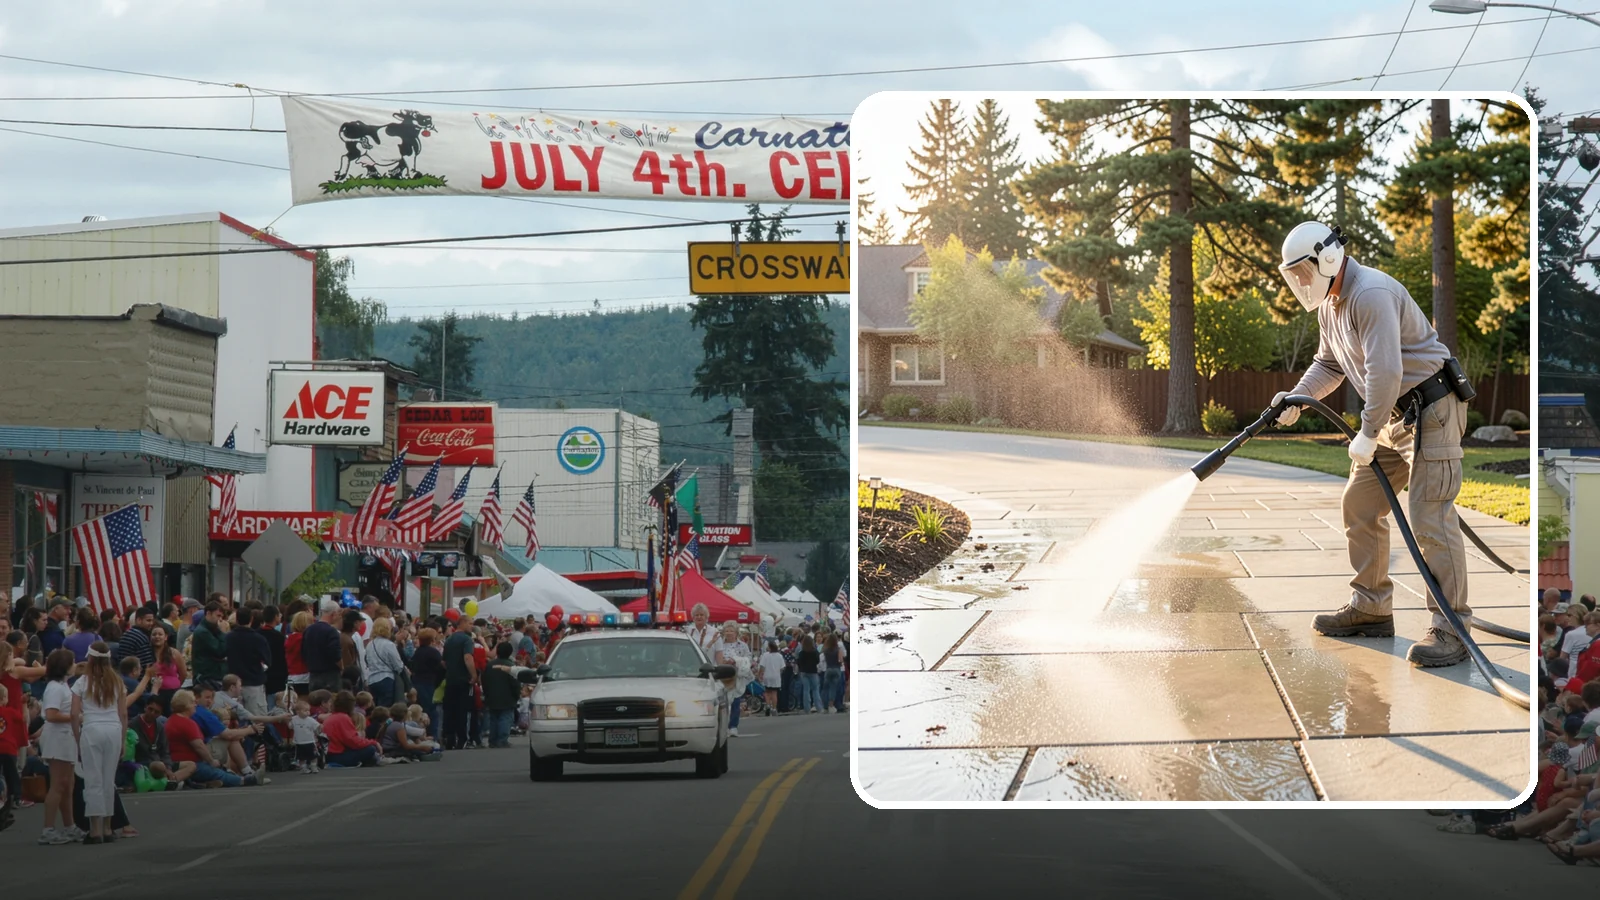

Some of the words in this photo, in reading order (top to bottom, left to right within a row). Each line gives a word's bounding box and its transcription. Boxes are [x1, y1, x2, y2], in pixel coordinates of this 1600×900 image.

[695, 121, 850, 149] Carnat
[481, 141, 605, 193] JULY
[632, 150, 746, 198] 4th.
[697, 254, 850, 279] CROSSWA
[283, 380, 373, 420] ACE
[405, 409, 452, 422] CEDAR
[461, 409, 485, 421] LOG
[283, 421, 370, 436] Hardware
[353, 467, 384, 482] Simpl
[95, 485, 124, 495] Vincent
[126, 485, 136, 495] de
[137, 486, 155, 495] Paul
[688, 527, 741, 535] CRNATION
